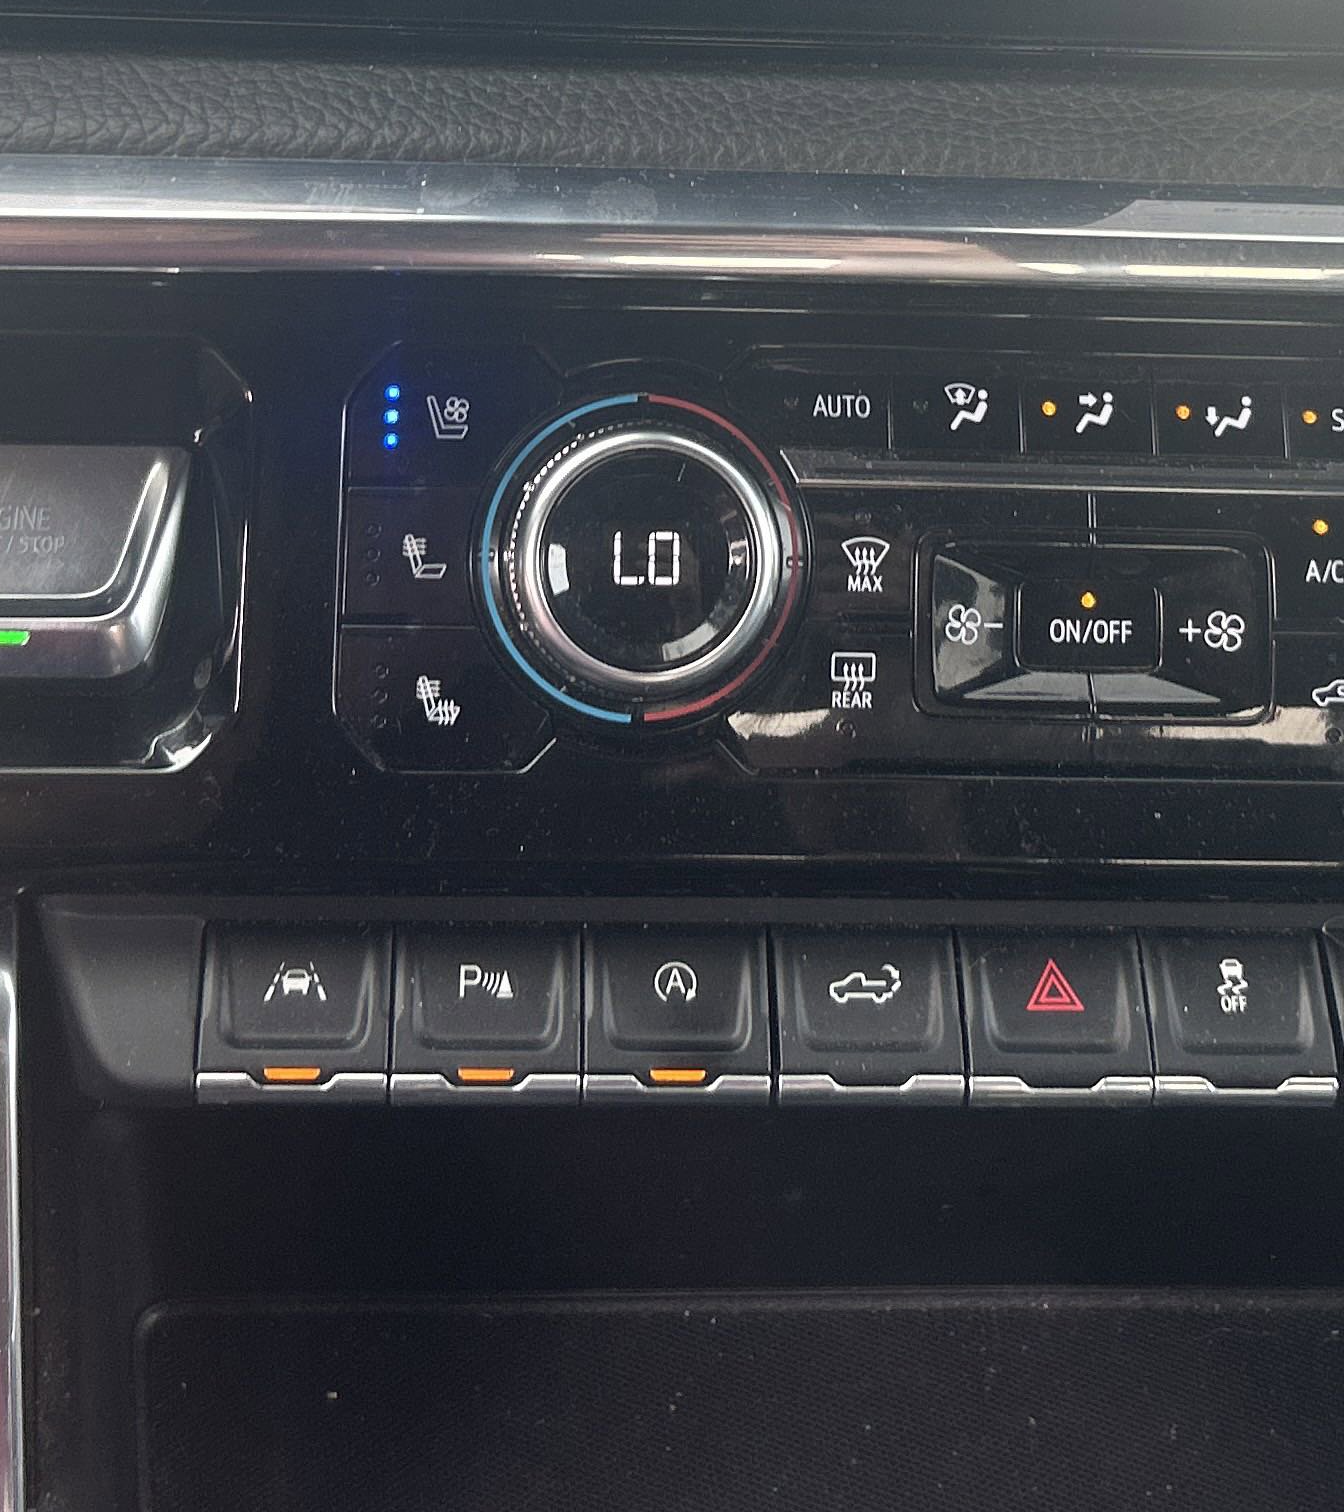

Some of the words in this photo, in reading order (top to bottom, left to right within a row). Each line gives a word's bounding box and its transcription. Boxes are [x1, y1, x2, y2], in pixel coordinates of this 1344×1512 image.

[812, 394, 871, 419] AUTO
[19, 535, 65, 553] STOP
[613, 530, 681, 586] LO
[1305, 559, 1344, 584] A/C
[846, 573, 883, 593] MAX
[1048, 618, 1133, 645] ON/OFF
[831, 689, 873, 709] REAR
[1219, 995, 1248, 1013] OFF
